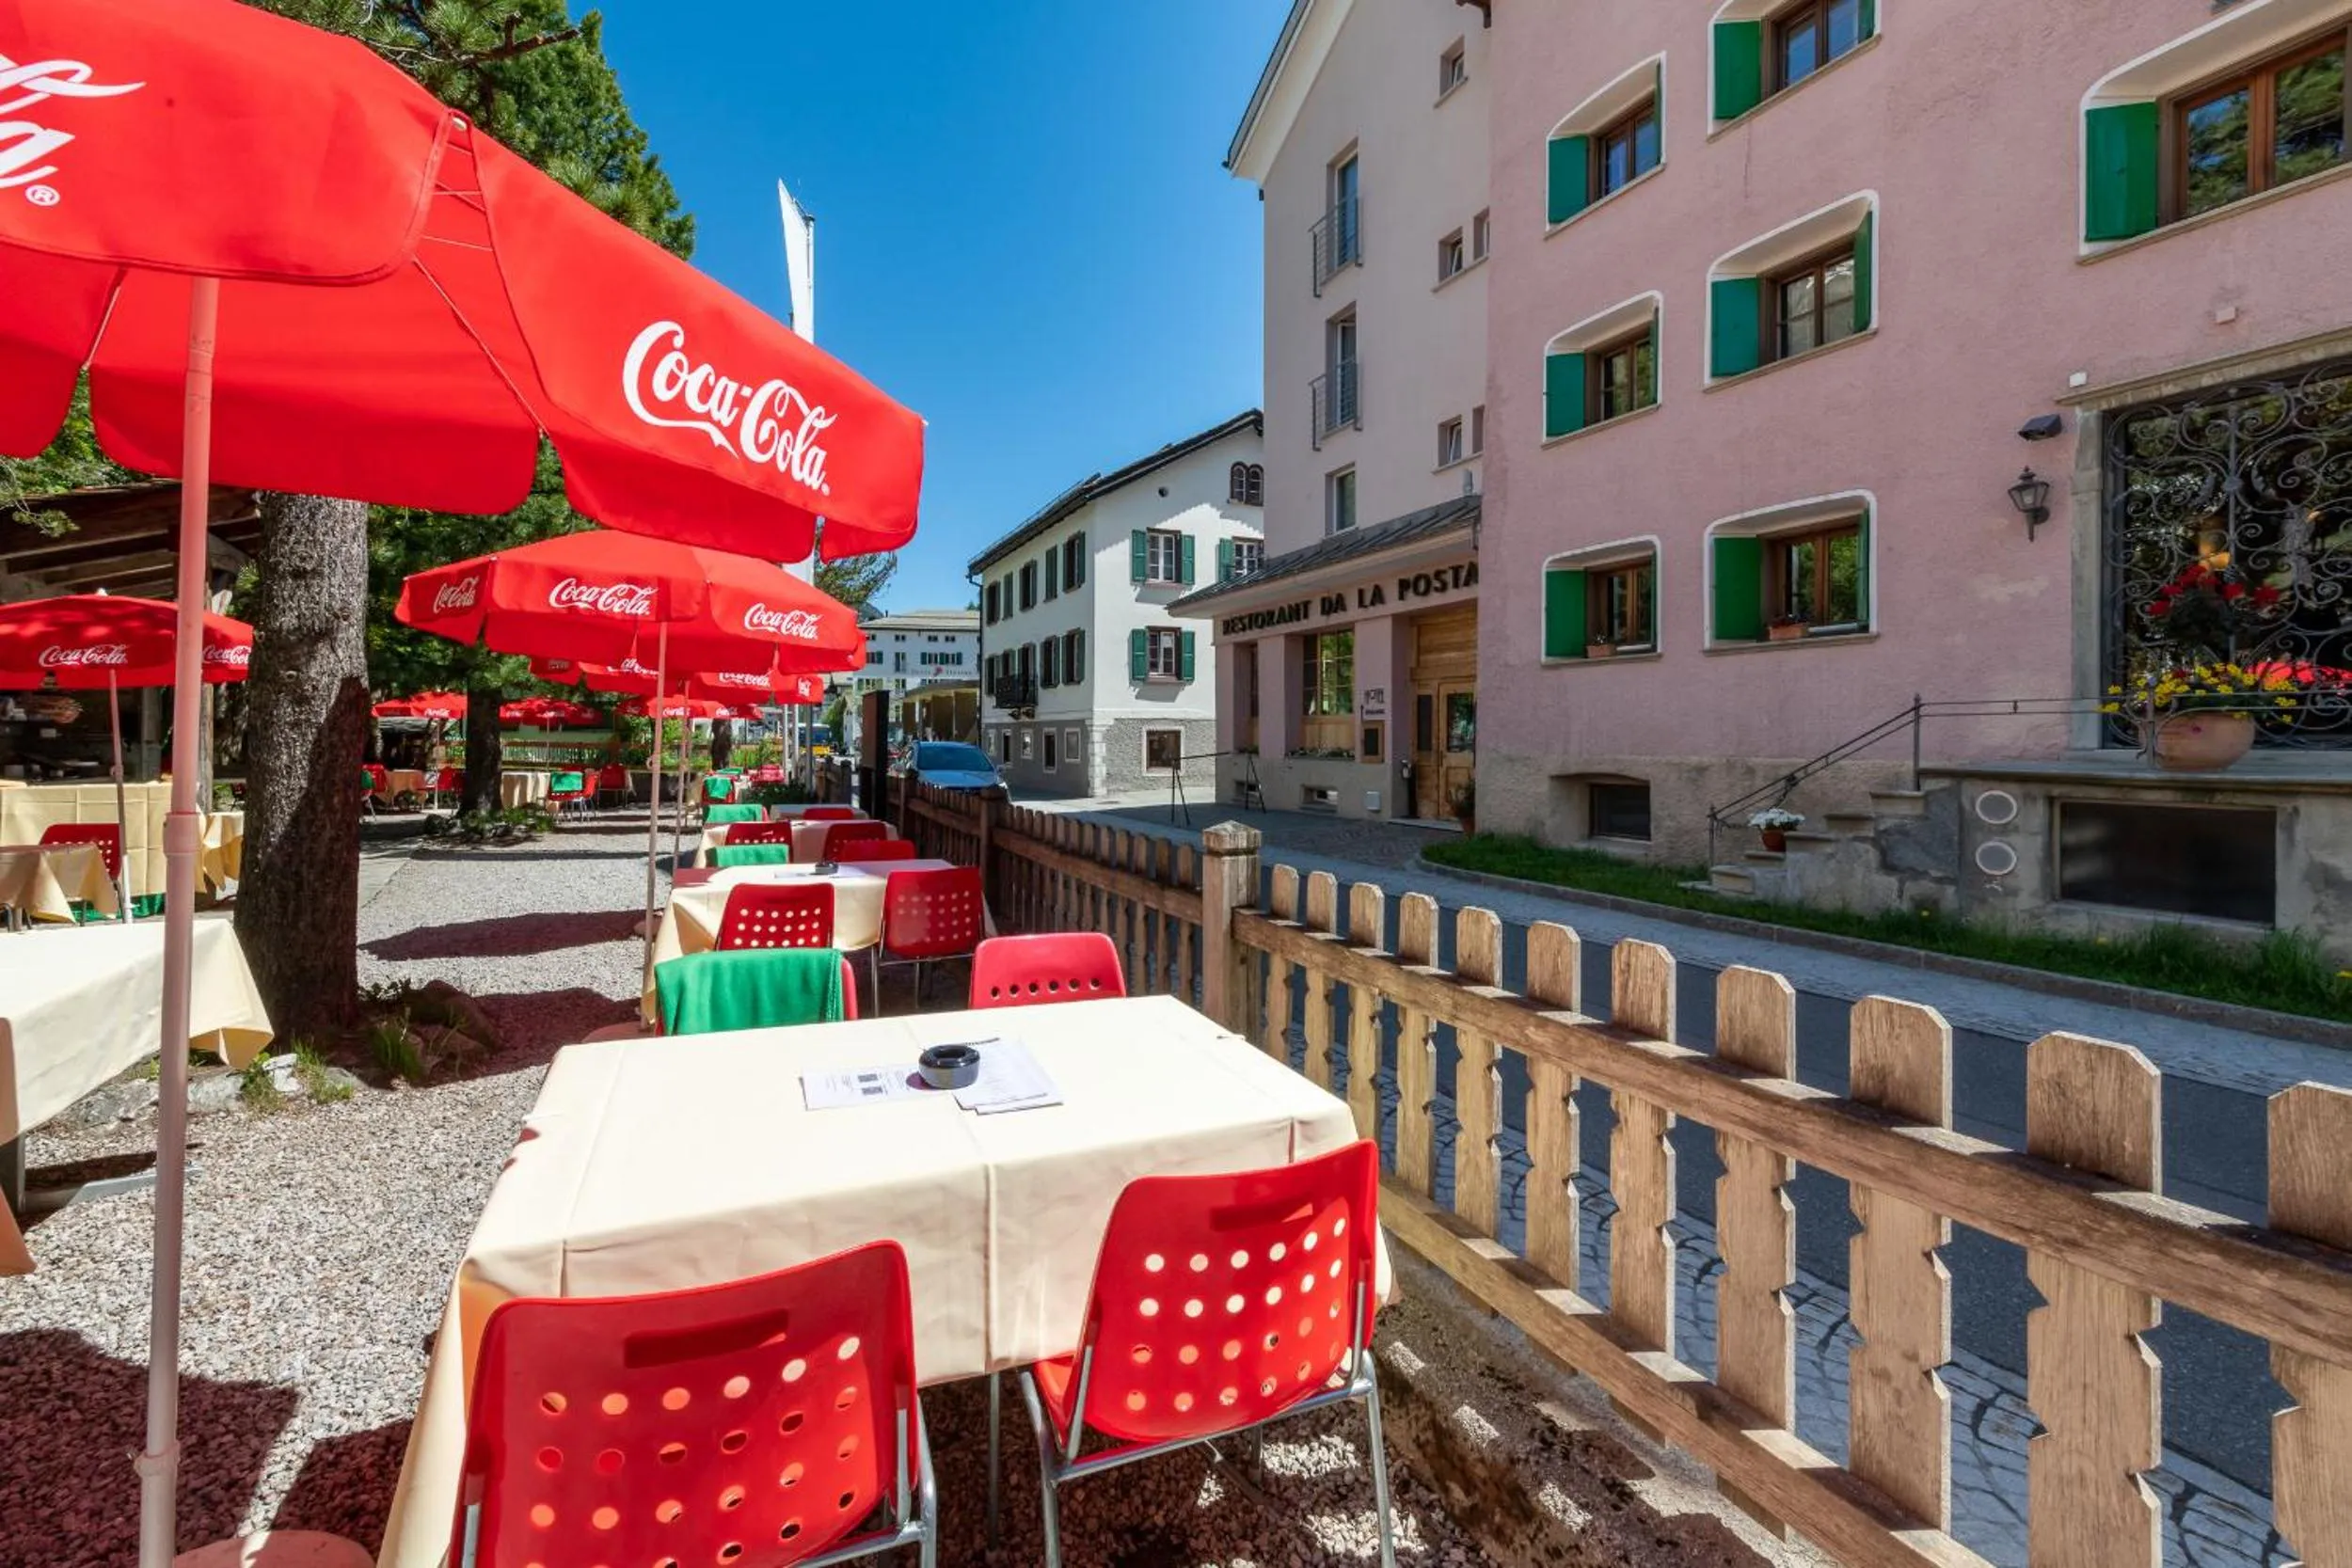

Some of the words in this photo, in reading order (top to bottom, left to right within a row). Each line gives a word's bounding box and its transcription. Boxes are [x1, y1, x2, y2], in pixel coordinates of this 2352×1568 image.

[1222, 599, 1312, 636] RESTORANT
[1319, 592, 1347, 616] DA
[1358, 583, 1386, 610] LA
[1398, 561, 1479, 602] POSTA
